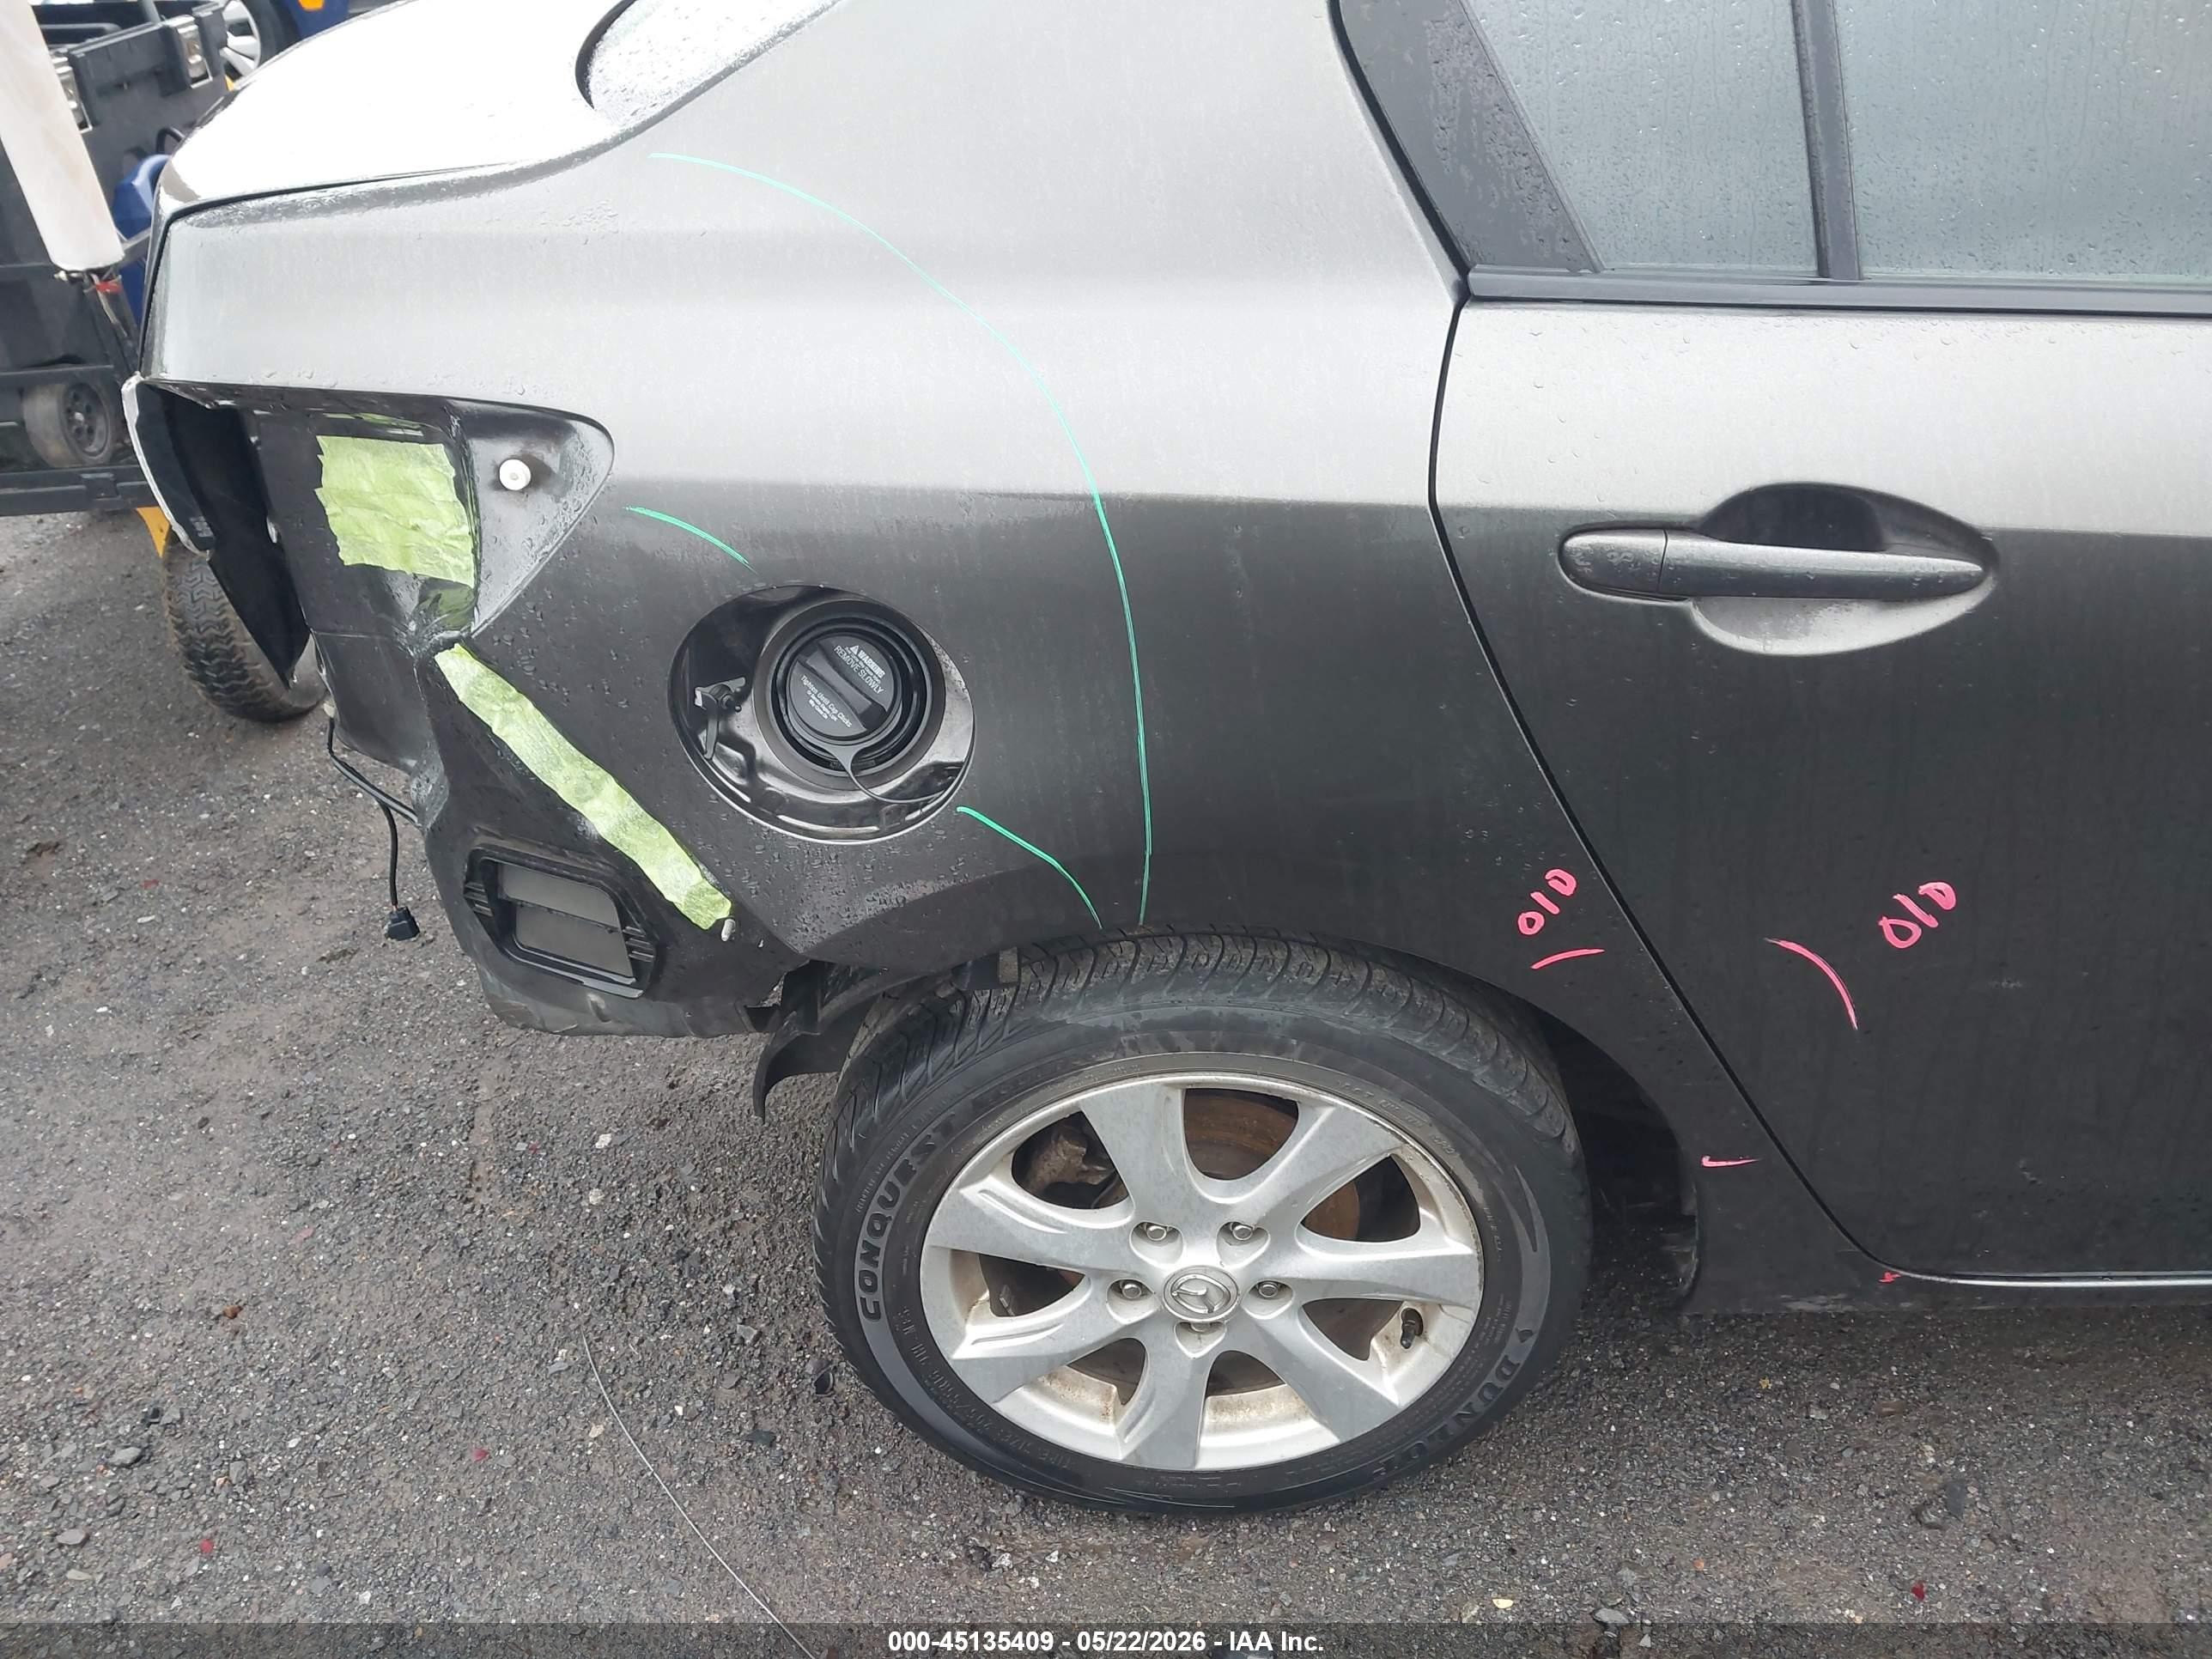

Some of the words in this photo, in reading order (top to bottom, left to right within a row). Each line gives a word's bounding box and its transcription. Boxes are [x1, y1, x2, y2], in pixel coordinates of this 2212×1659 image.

[834, 645, 861, 672] REMOVE
[858, 669, 884, 694] SLOWLY
[858, 650, 885, 678] WARNING
[801, 675, 818, 694] Tighten
[829, 703, 839, 714] Cap
[857, 1112, 956, 1322] CONQUEST
